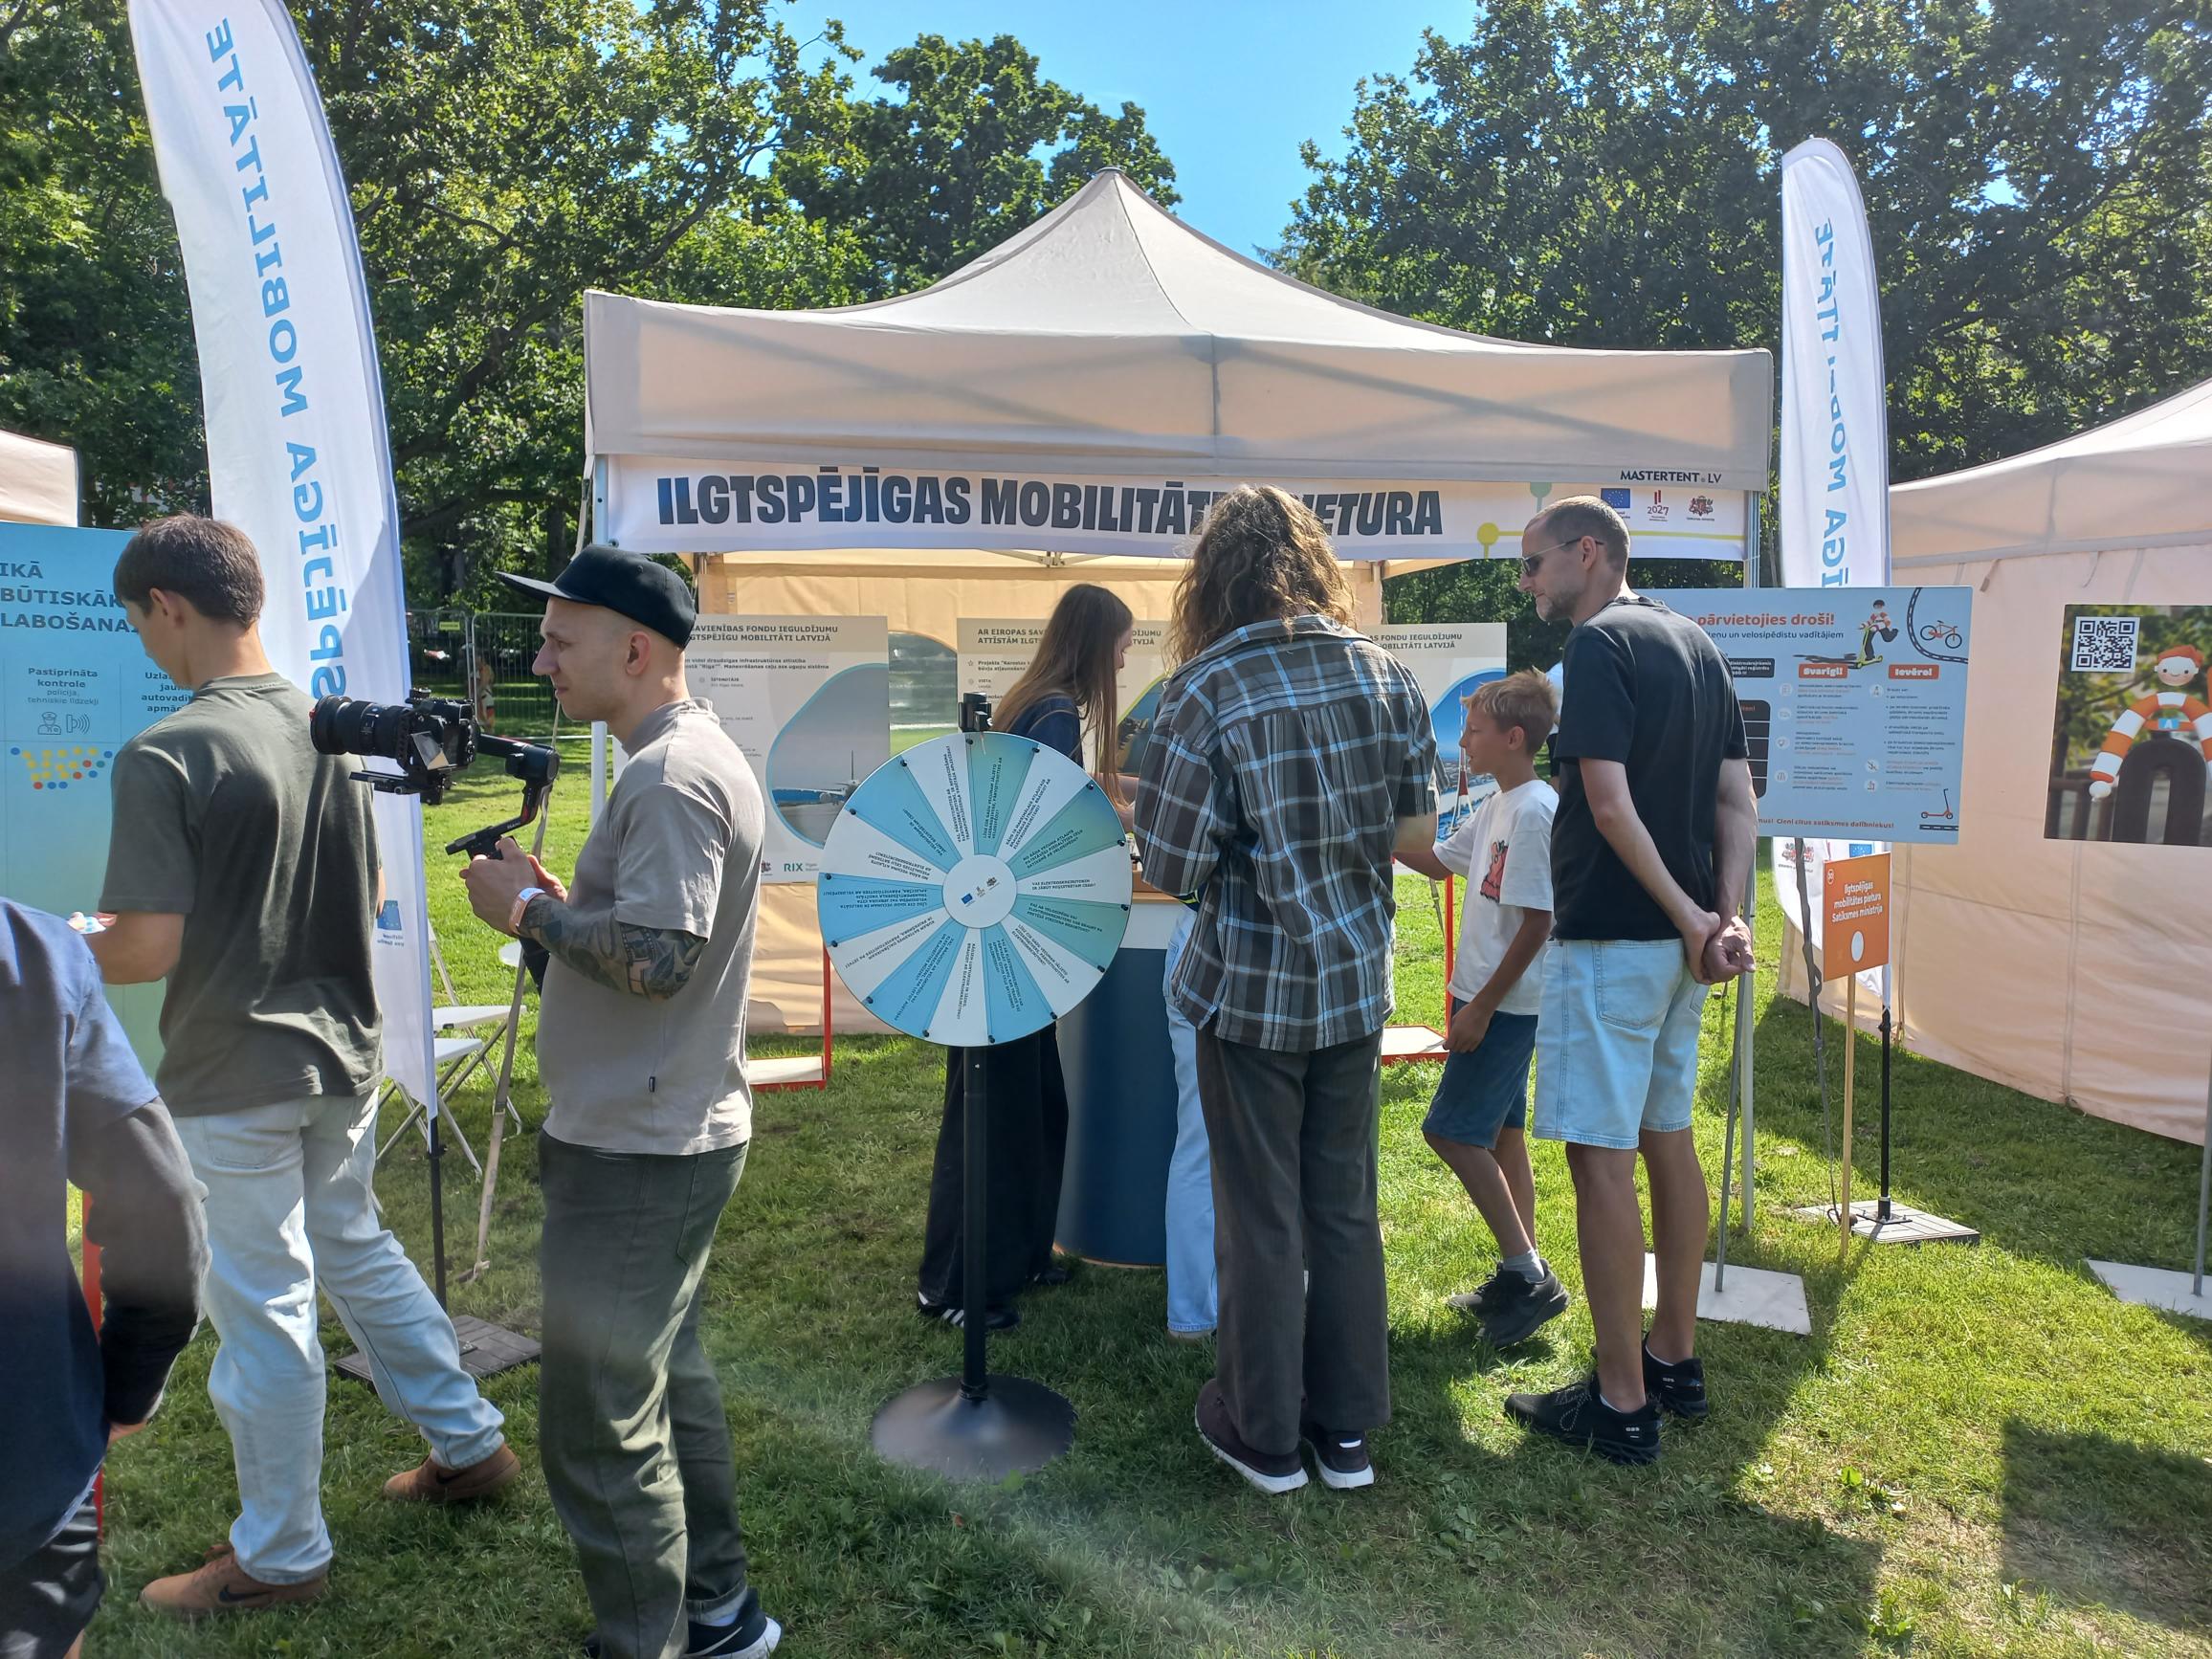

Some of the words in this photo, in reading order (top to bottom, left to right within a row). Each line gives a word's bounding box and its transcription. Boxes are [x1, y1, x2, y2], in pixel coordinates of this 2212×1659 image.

[656, 466, 971, 525] ILGTSPĒJĪGAS
[981, 478, 1228, 536] MOBILITĀT
[1301, 490, 1444, 537] ETURA
[1647, 504, 1670, 516] 2027
[0, 585, 126, 608] BŪTISKĀK
[0, 611, 139, 633] LABOŠANA
[1697, 613, 1787, 628] pārvietojies
[1790, 612, 1835, 626] droši!
[692, 624, 743, 632] AVIENĪBAS
[691, 632, 739, 641] GTSPĒJĪGU
[795, 633, 830, 642] LATVIJĀ
[1409, 632, 1462, 641] IEGULDĪJUMU
[1799, 630, 1845, 640] vadītājiem
[36, 678, 86, 688] kontrole
[784, 863, 804, 872] RIX
